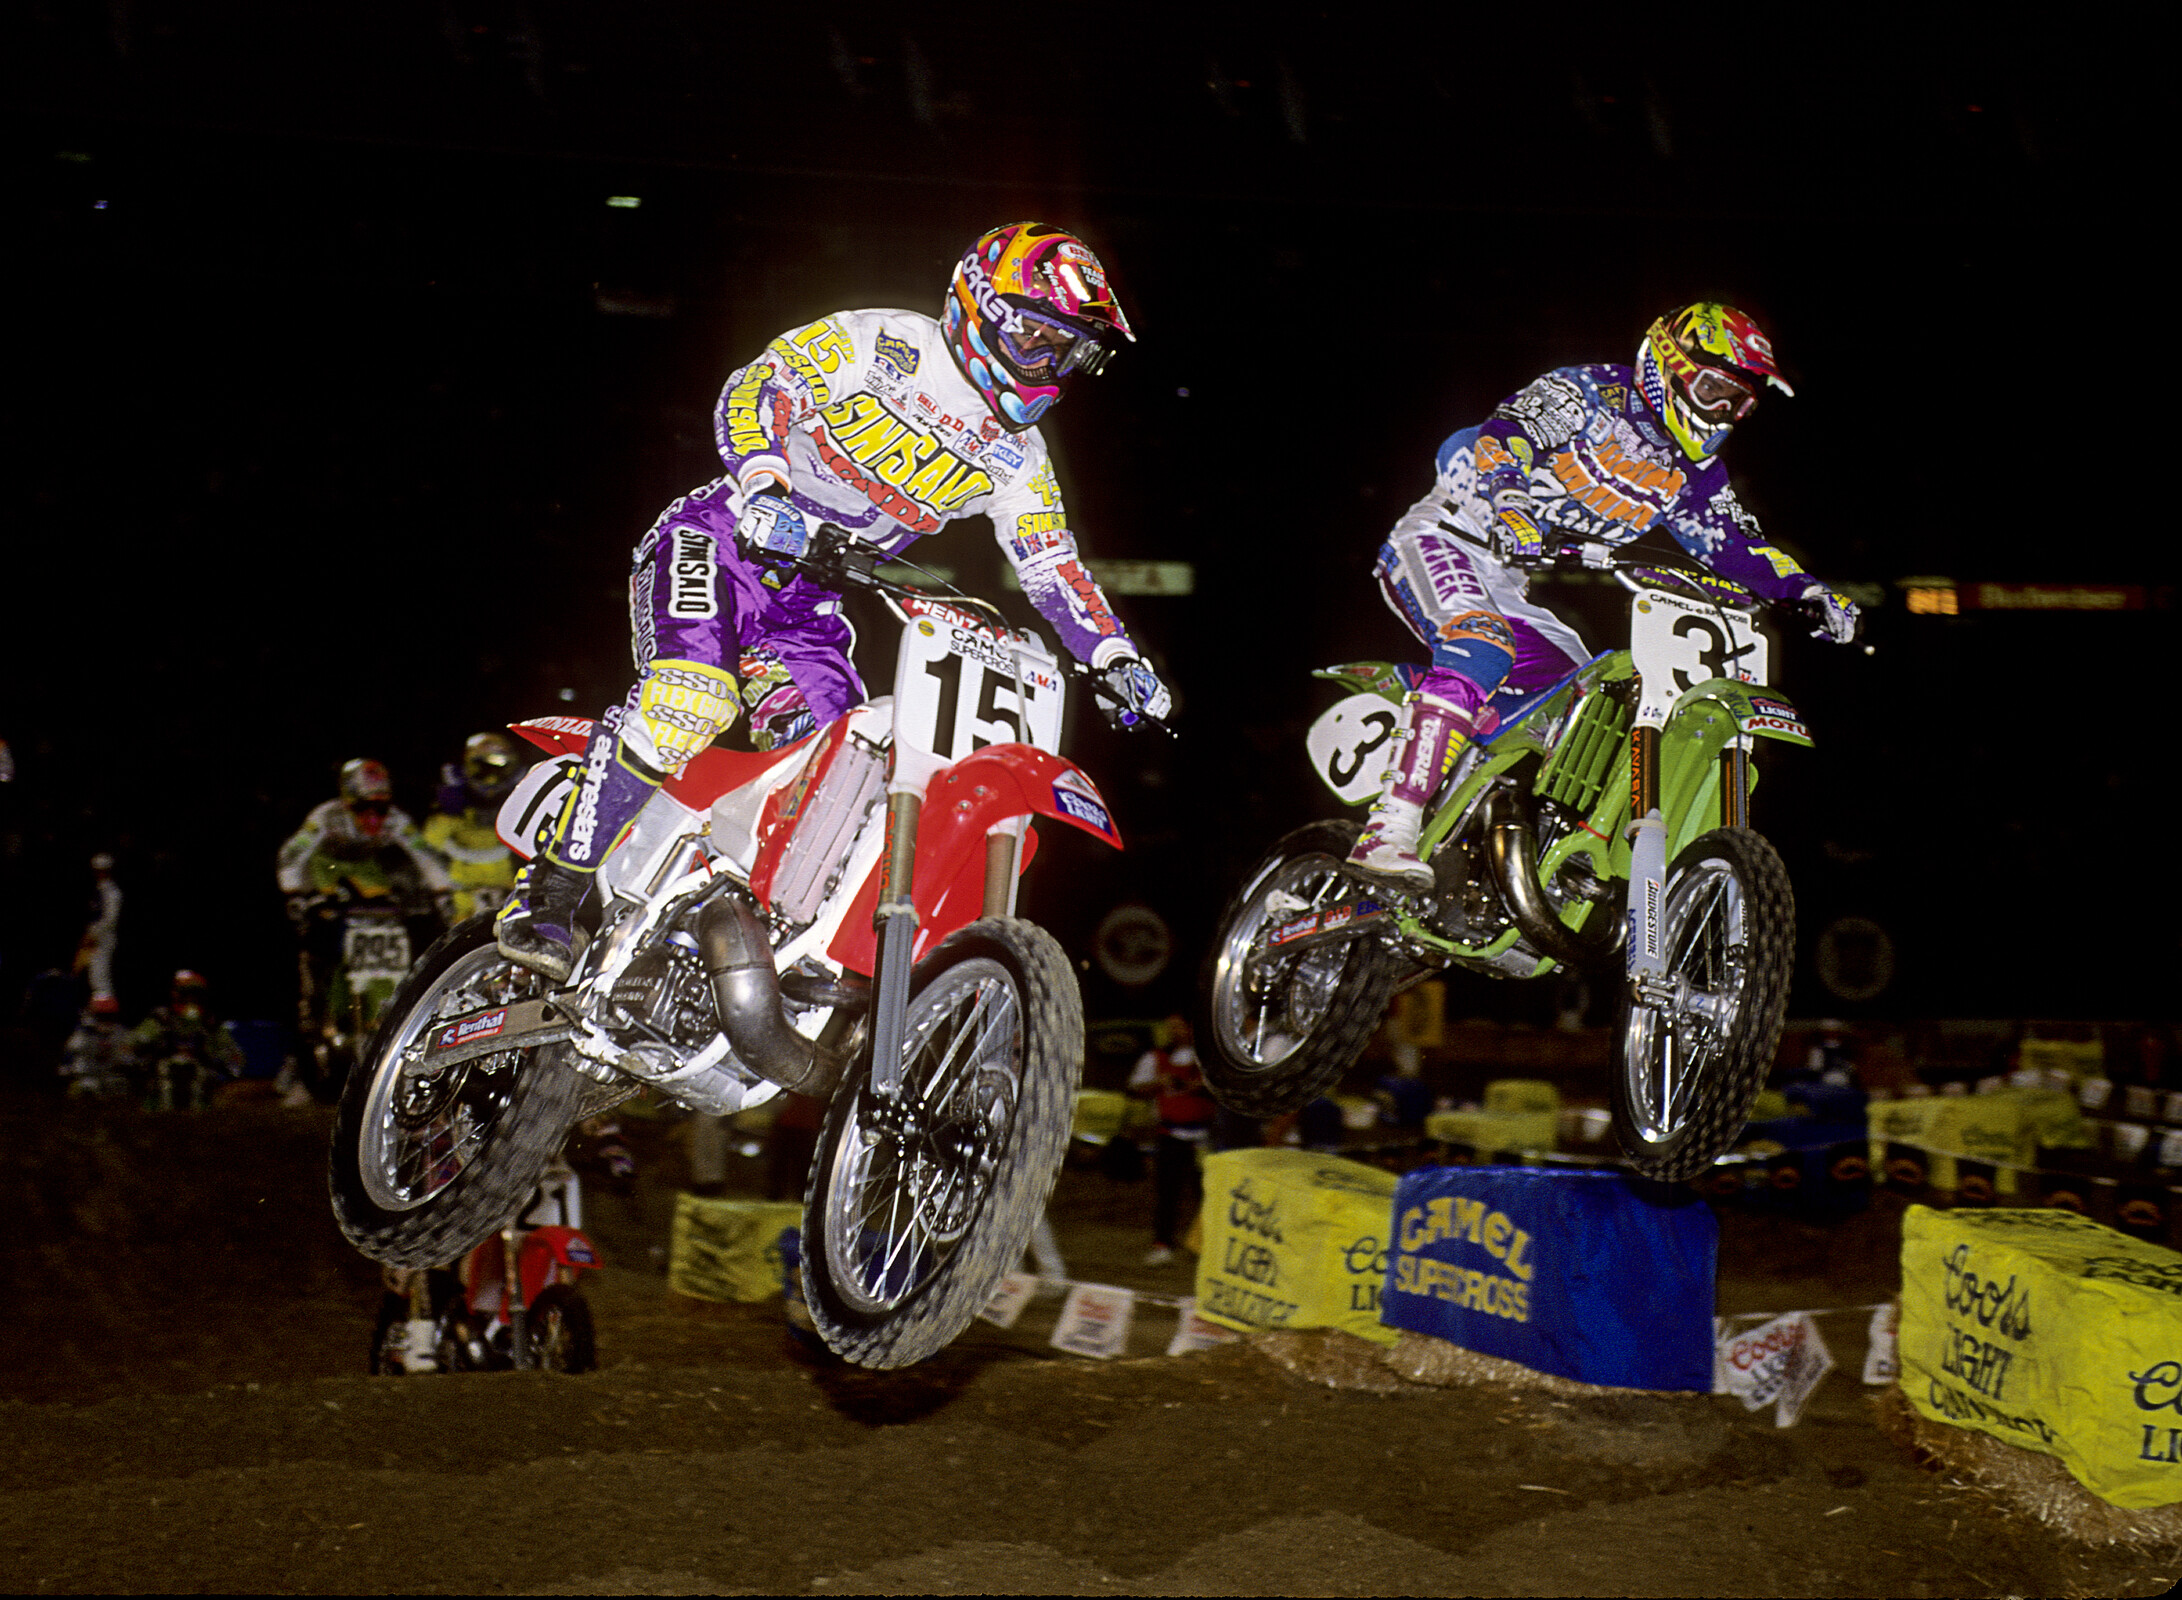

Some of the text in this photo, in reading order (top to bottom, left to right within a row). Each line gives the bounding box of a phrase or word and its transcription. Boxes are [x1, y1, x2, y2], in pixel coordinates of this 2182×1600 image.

[963, 253, 1024, 333] OAKLEY
[767, 337, 830, 404] NISALO
[791, 320, 841, 373] 15
[876, 335, 917, 366] CAMEL
[1650, 321, 1697, 376] SCOTT
[916, 393, 938, 414] BELL
[675, 529, 713, 613] SINISALO
[1650, 593, 1695, 612] CAMEL
[950, 640, 1016, 678] SUPERCROS
[1025, 671, 1057, 691] AMA
[1673, 615, 1727, 693] 3
[650, 682, 697, 713] FLEX
[925, 651, 1036, 760] 15
[1759, 706, 1797, 721] LIGHT
[519, 716, 594, 737] DUNLO
[1329, 710, 1396, 788] 3
[1747, 717, 1811, 738] MOTU
[568, 734, 613, 861] alpinestars
[1646, 879, 1660, 958] BRIDGESTONE
[457, 1012, 505, 1037] Renthal
[1401, 1197, 1534, 1279] CAMEL
[1395, 1255, 1530, 1323] SUPERCROSS
[1942, 1244, 2032, 1342] Coors
